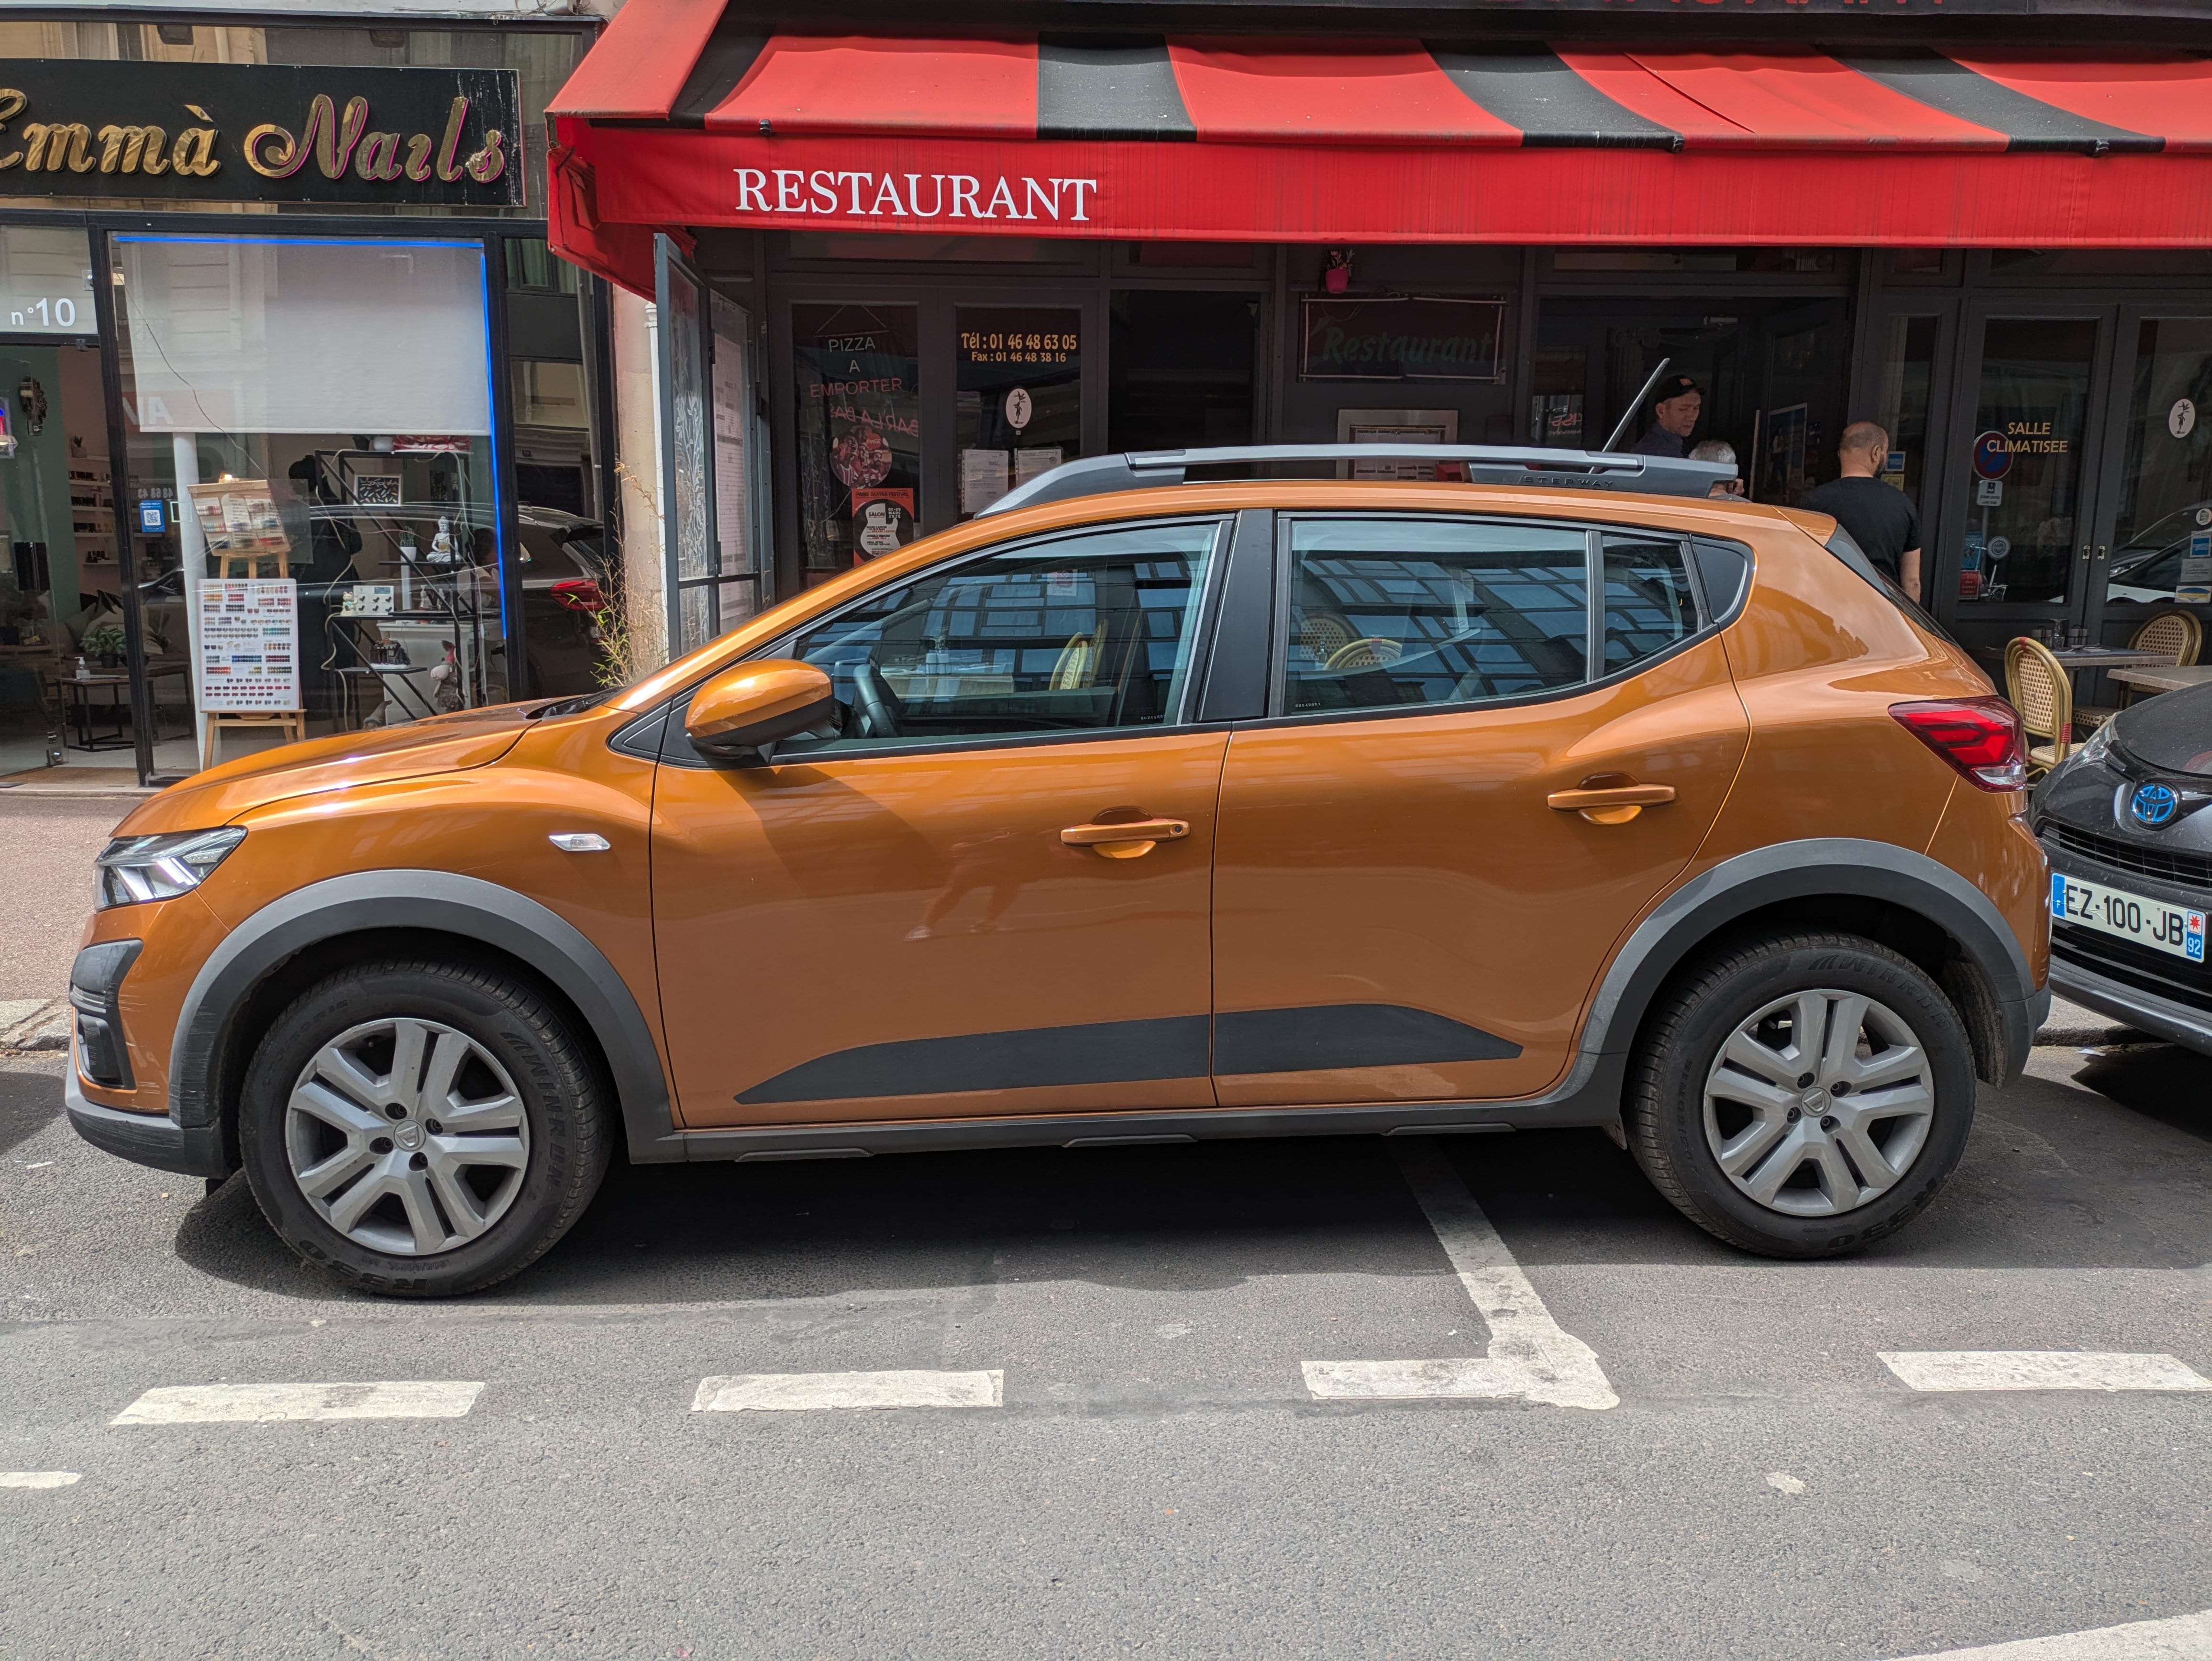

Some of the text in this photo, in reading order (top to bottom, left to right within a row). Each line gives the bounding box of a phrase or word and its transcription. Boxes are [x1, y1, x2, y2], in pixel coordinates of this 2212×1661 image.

[733, 168, 1099, 223] RESTAURANT
[828, 336, 875, 353] PIZZA
[990, 333, 1003, 349] 01
[1008, 334, 1023, 350] 46
[1026, 334, 1041, 350] 48
[1044, 334, 1059, 350] 63
[1062, 334, 1077, 351] 05
[1323, 326, 1492, 363] Restaurant
[972, 351, 988, 362] Fax
[996, 352, 1006, 362] 01
[1010, 352, 1022, 362] 46
[1025, 352, 1037, 362] 48
[1040, 352, 1051, 362] 38
[1055, 353, 1066, 363] 16
[849, 359, 860, 373] A
[809, 377, 903, 398] EMPORTER
[2008, 422, 2051, 435] SALLE
[1987, 440, 2068, 454] CLIMATISEE
[1524, 476, 1613, 487] STEPWAY
[2056, 900, 2060, 908] F
[2187, 937, 2201, 955] 92
